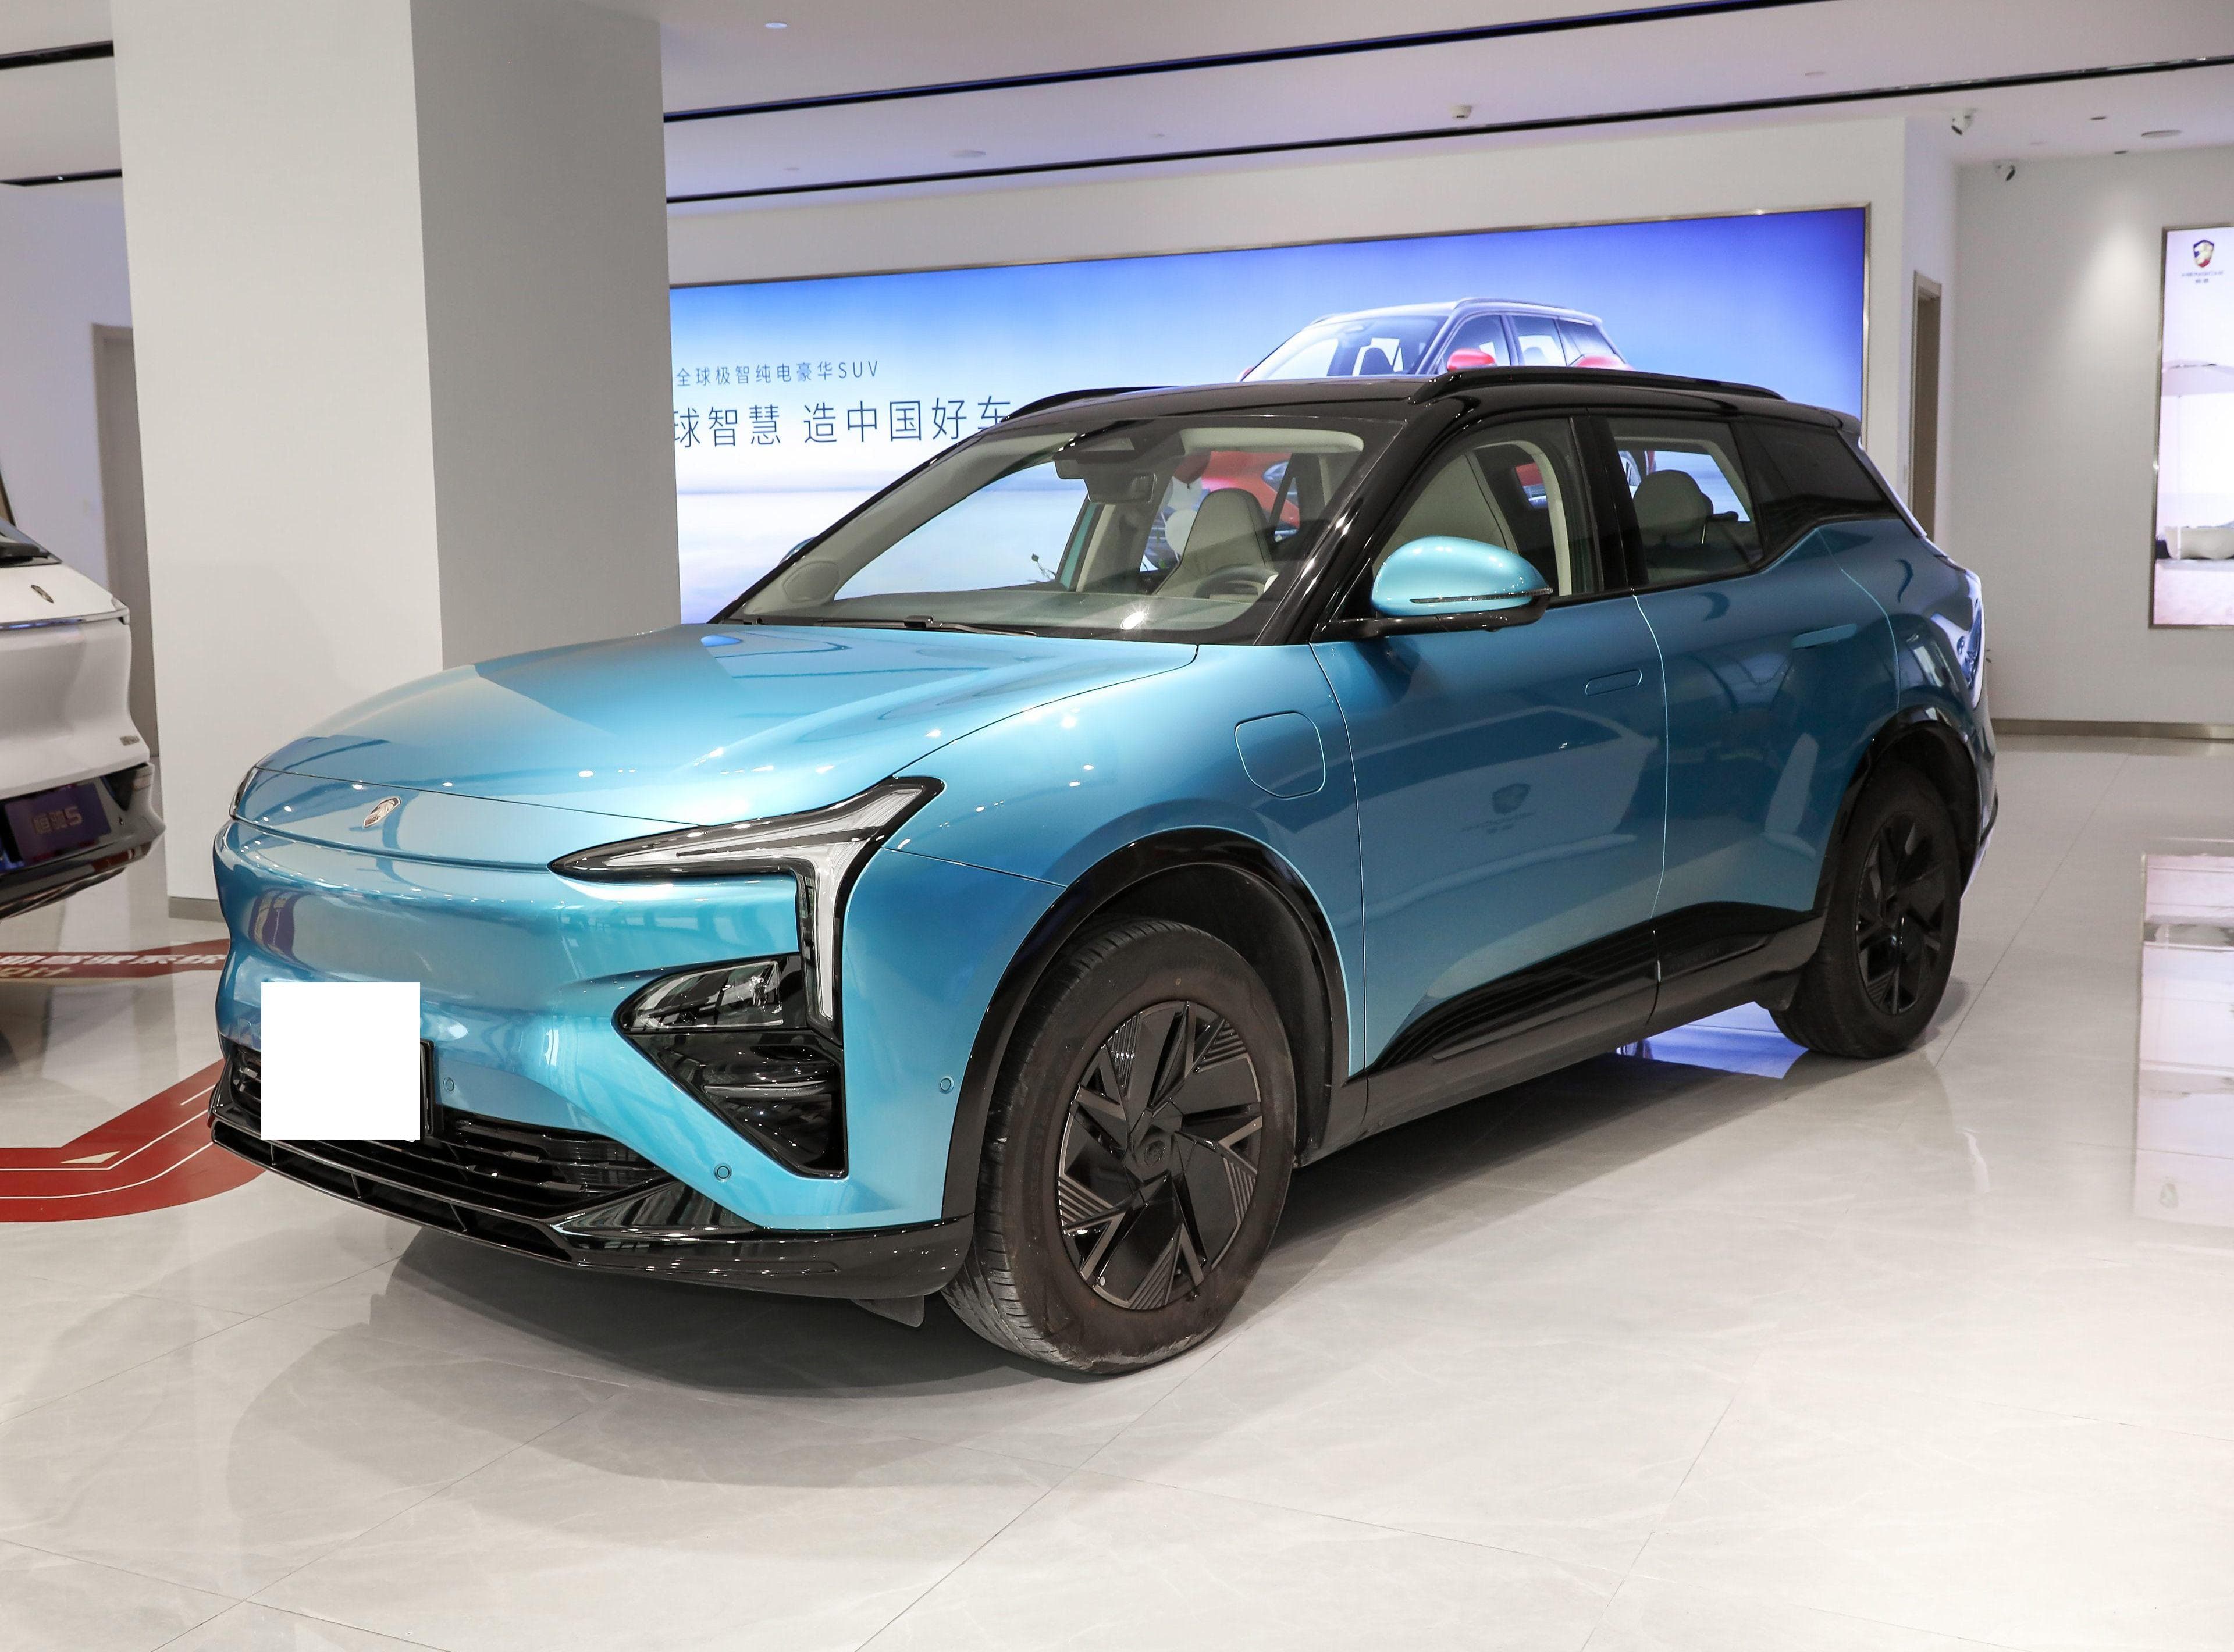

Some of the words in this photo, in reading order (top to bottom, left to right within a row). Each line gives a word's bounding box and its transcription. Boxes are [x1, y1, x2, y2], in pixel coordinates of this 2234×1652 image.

[676, 361, 878, 387] 全球极智纯电豪华SUV
